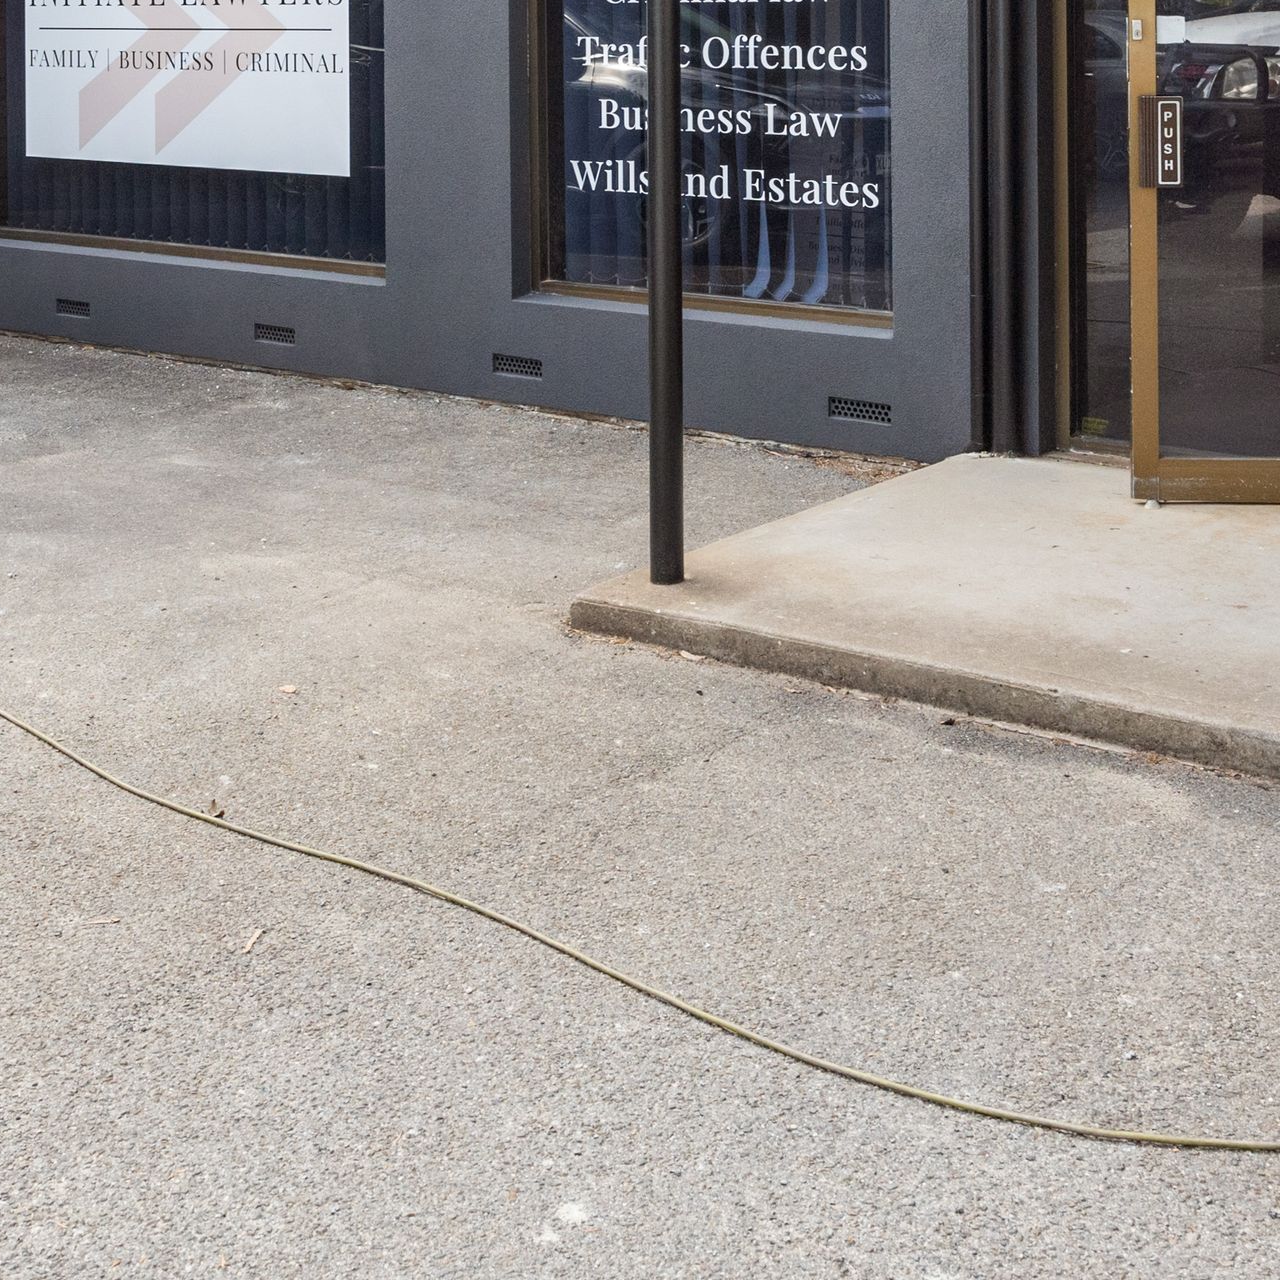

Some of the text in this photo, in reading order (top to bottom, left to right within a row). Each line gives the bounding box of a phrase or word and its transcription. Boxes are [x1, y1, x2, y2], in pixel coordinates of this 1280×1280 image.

[30, 49, 343, 74] FAMILY BUSINESS CRIMINAL
[577, 34, 868, 71] Trafc Offences
[599, 99, 842, 137] Buness Law
[1163, 111, 1174, 171] PUSH
[570, 159, 880, 208] Wills nd Estates
